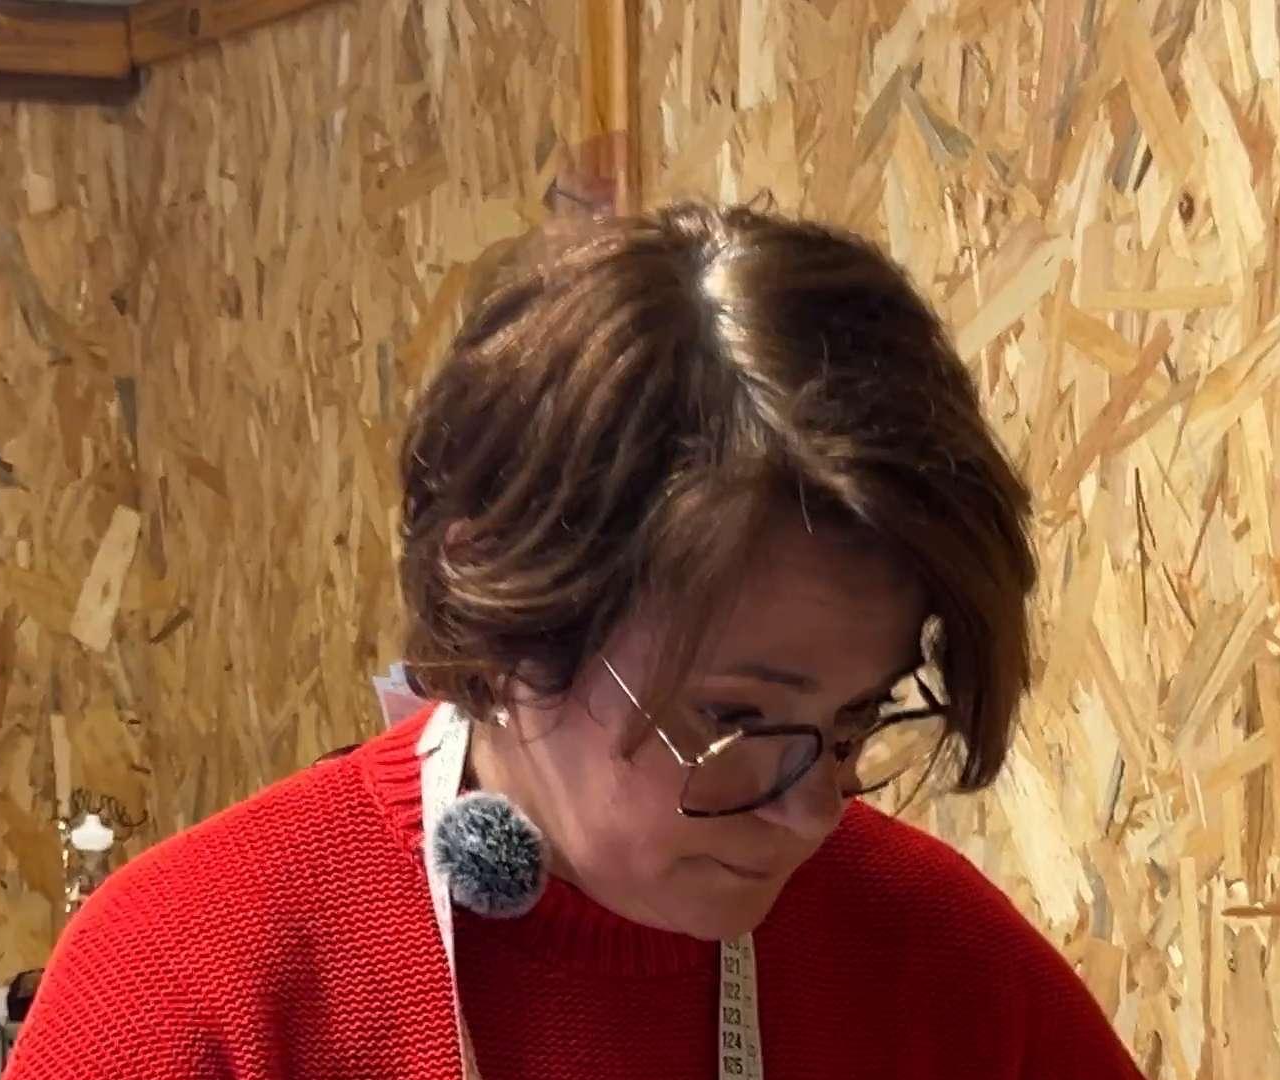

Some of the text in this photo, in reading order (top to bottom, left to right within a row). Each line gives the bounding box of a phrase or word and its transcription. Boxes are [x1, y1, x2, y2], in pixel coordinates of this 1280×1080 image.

[722, 1007, 741, 1025] 123
[722, 1031, 742, 1049] 124
[722, 1056, 743, 1074] 125
